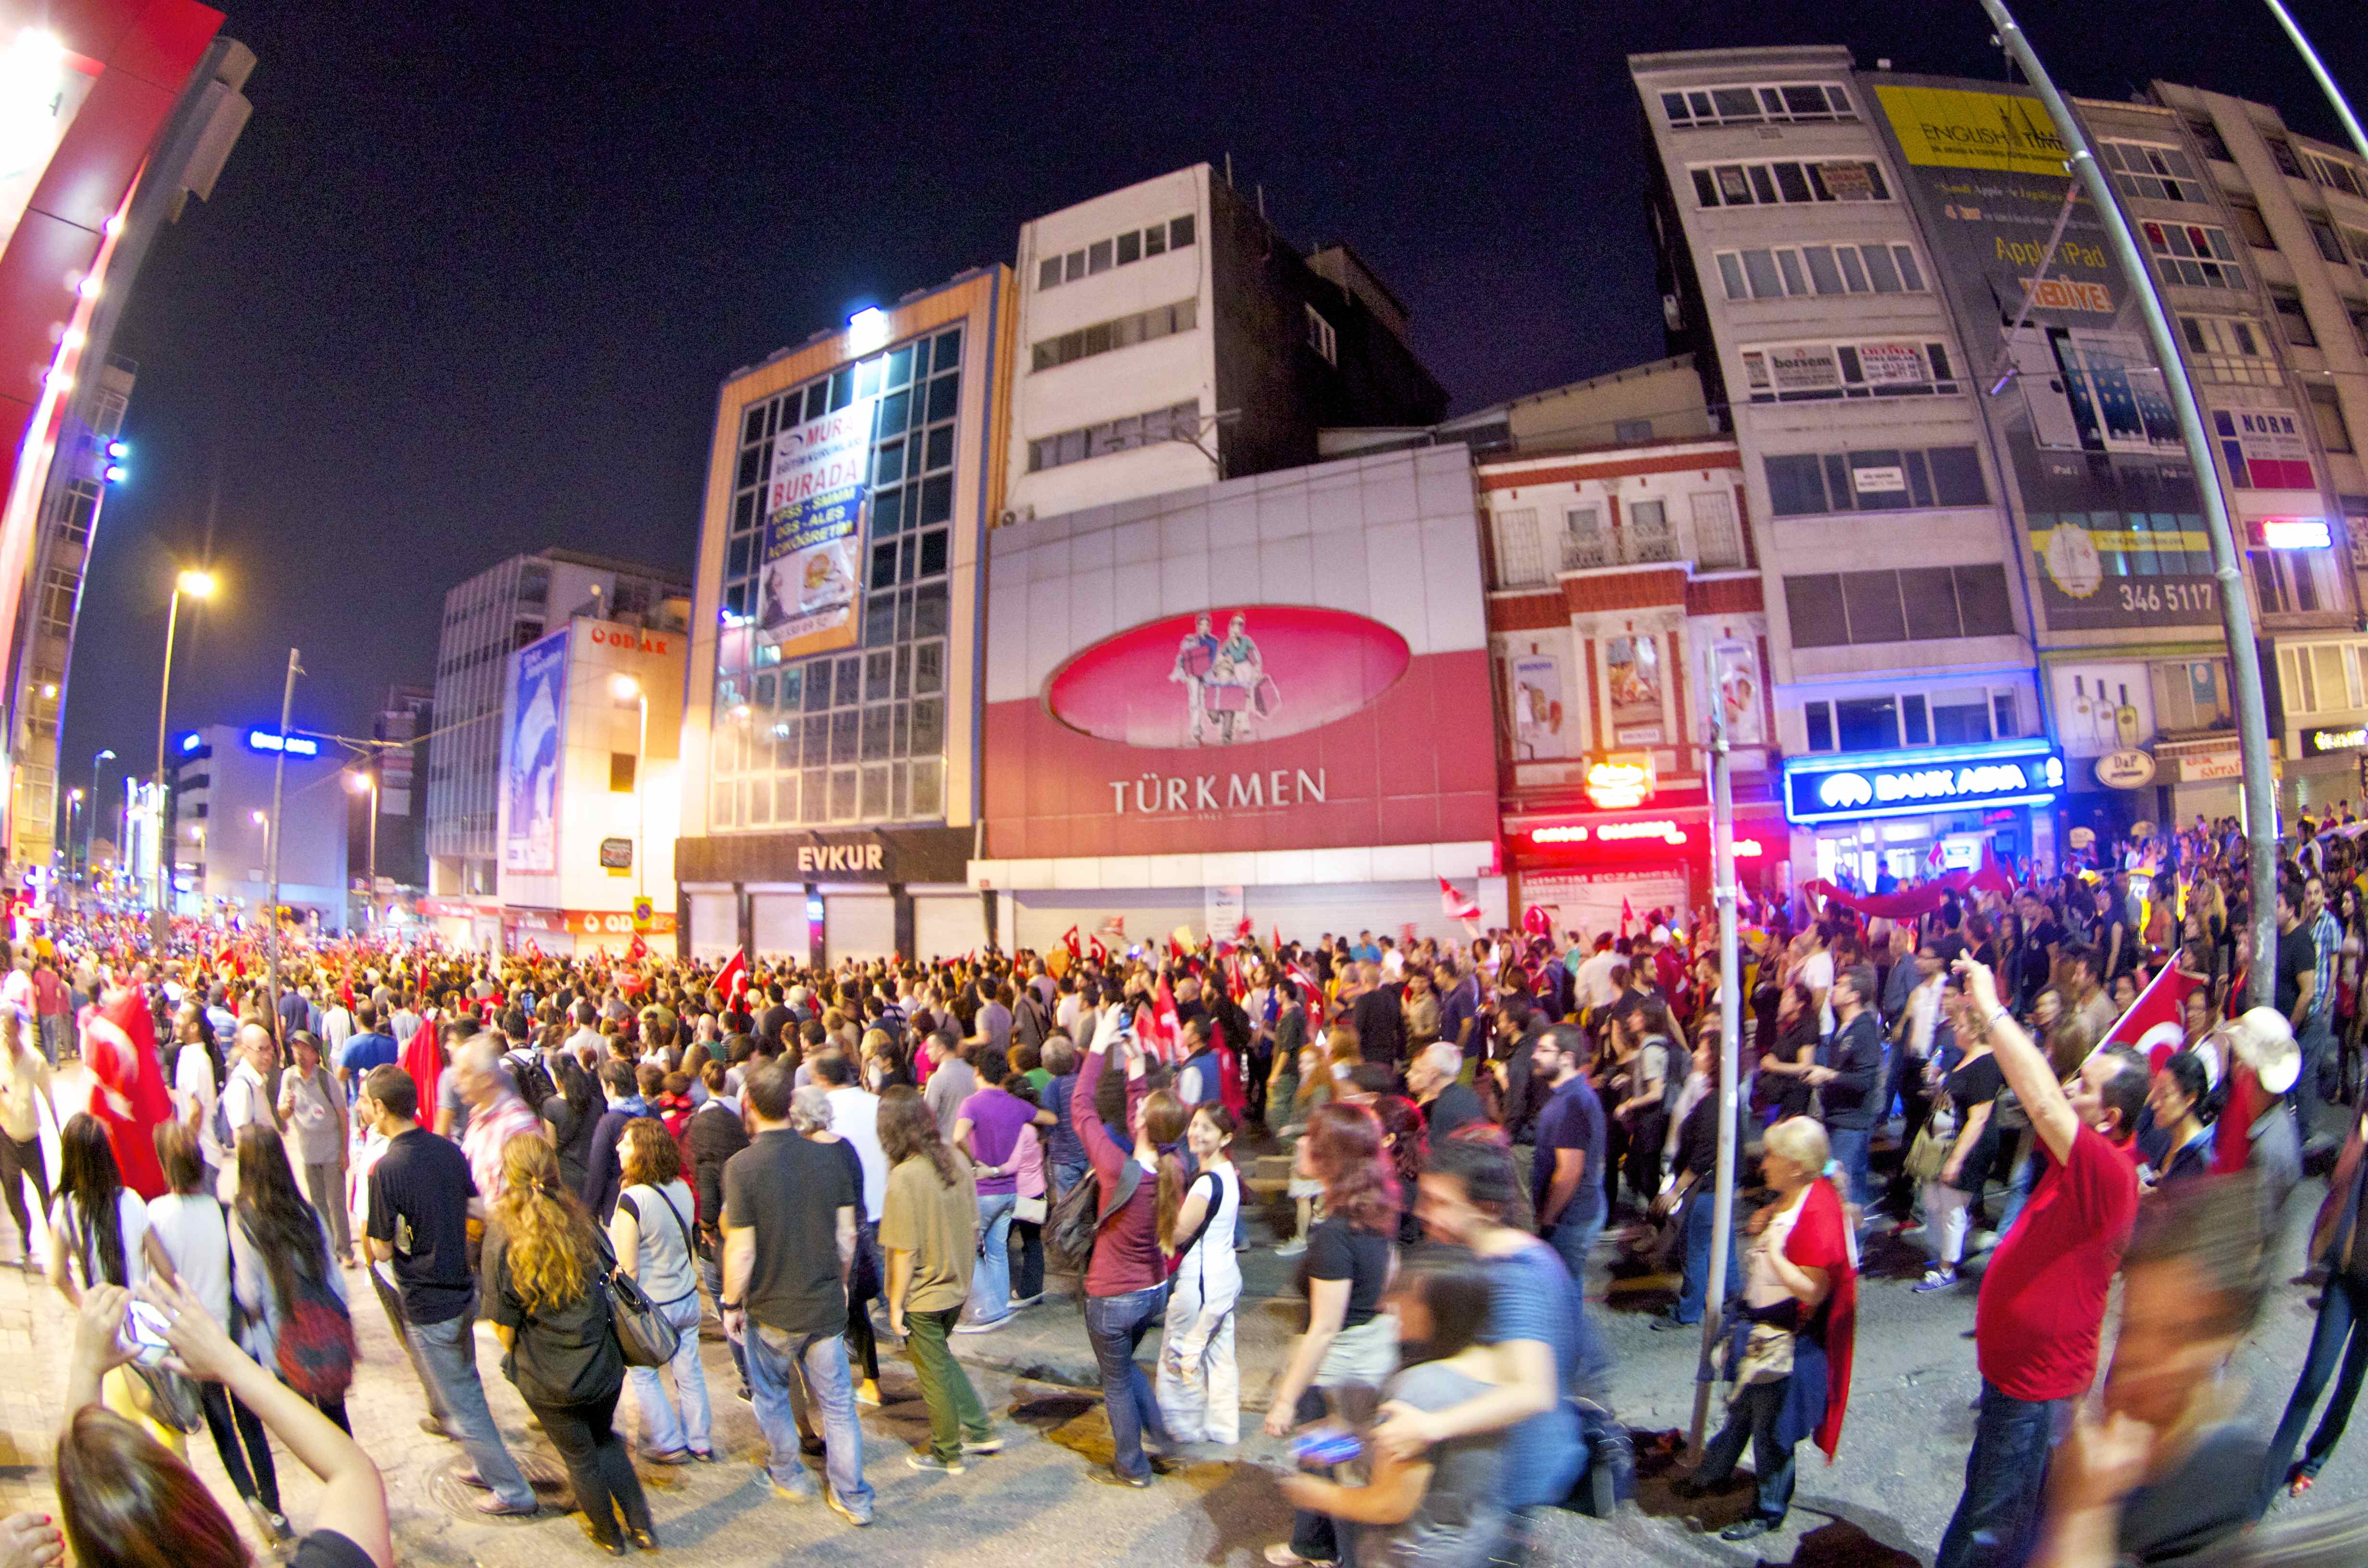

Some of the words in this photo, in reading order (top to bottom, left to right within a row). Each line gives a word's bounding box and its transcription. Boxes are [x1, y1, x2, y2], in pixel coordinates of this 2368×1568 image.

[1921, 123, 2010, 145] ENGLISH
[2060, 241, 2107, 268] iPad
[2242, 414, 2295, 434] NORM
[773, 459, 857, 508] BURADA
[809, 505, 846, 527] ALES
[2119, 584, 2161, 612] 346
[2164, 583, 2212, 612] 5117
[1109, 767, 1325, 815] TÜRKMEN
[1875, 769, 1957, 801] BANK
[797, 844, 884, 872] EVKUR
